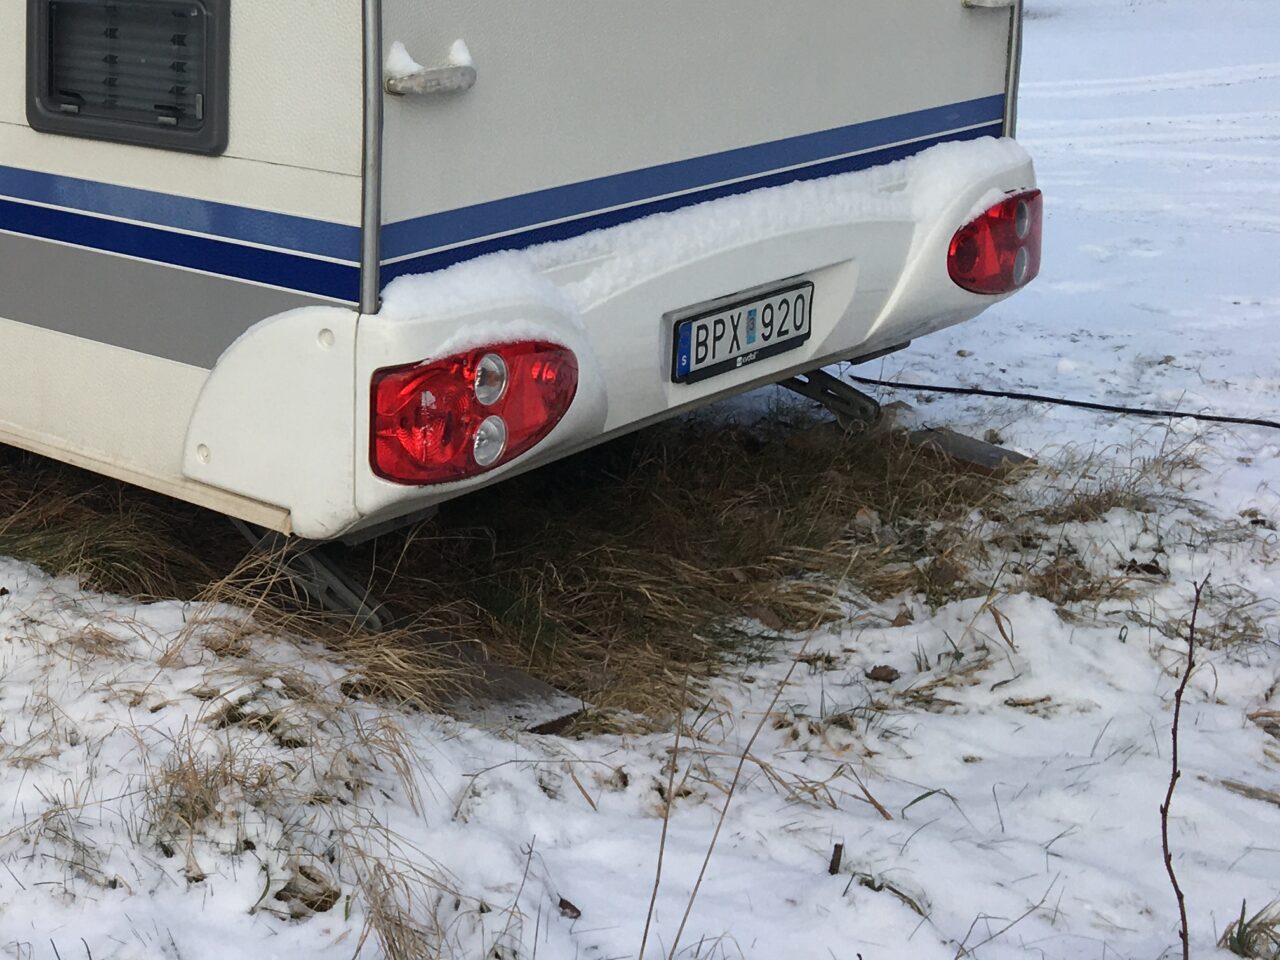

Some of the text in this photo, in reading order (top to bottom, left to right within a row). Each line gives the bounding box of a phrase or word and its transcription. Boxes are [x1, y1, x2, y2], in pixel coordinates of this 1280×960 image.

[695, 293, 806, 365] BPX 920
[681, 355, 687, 366] S
